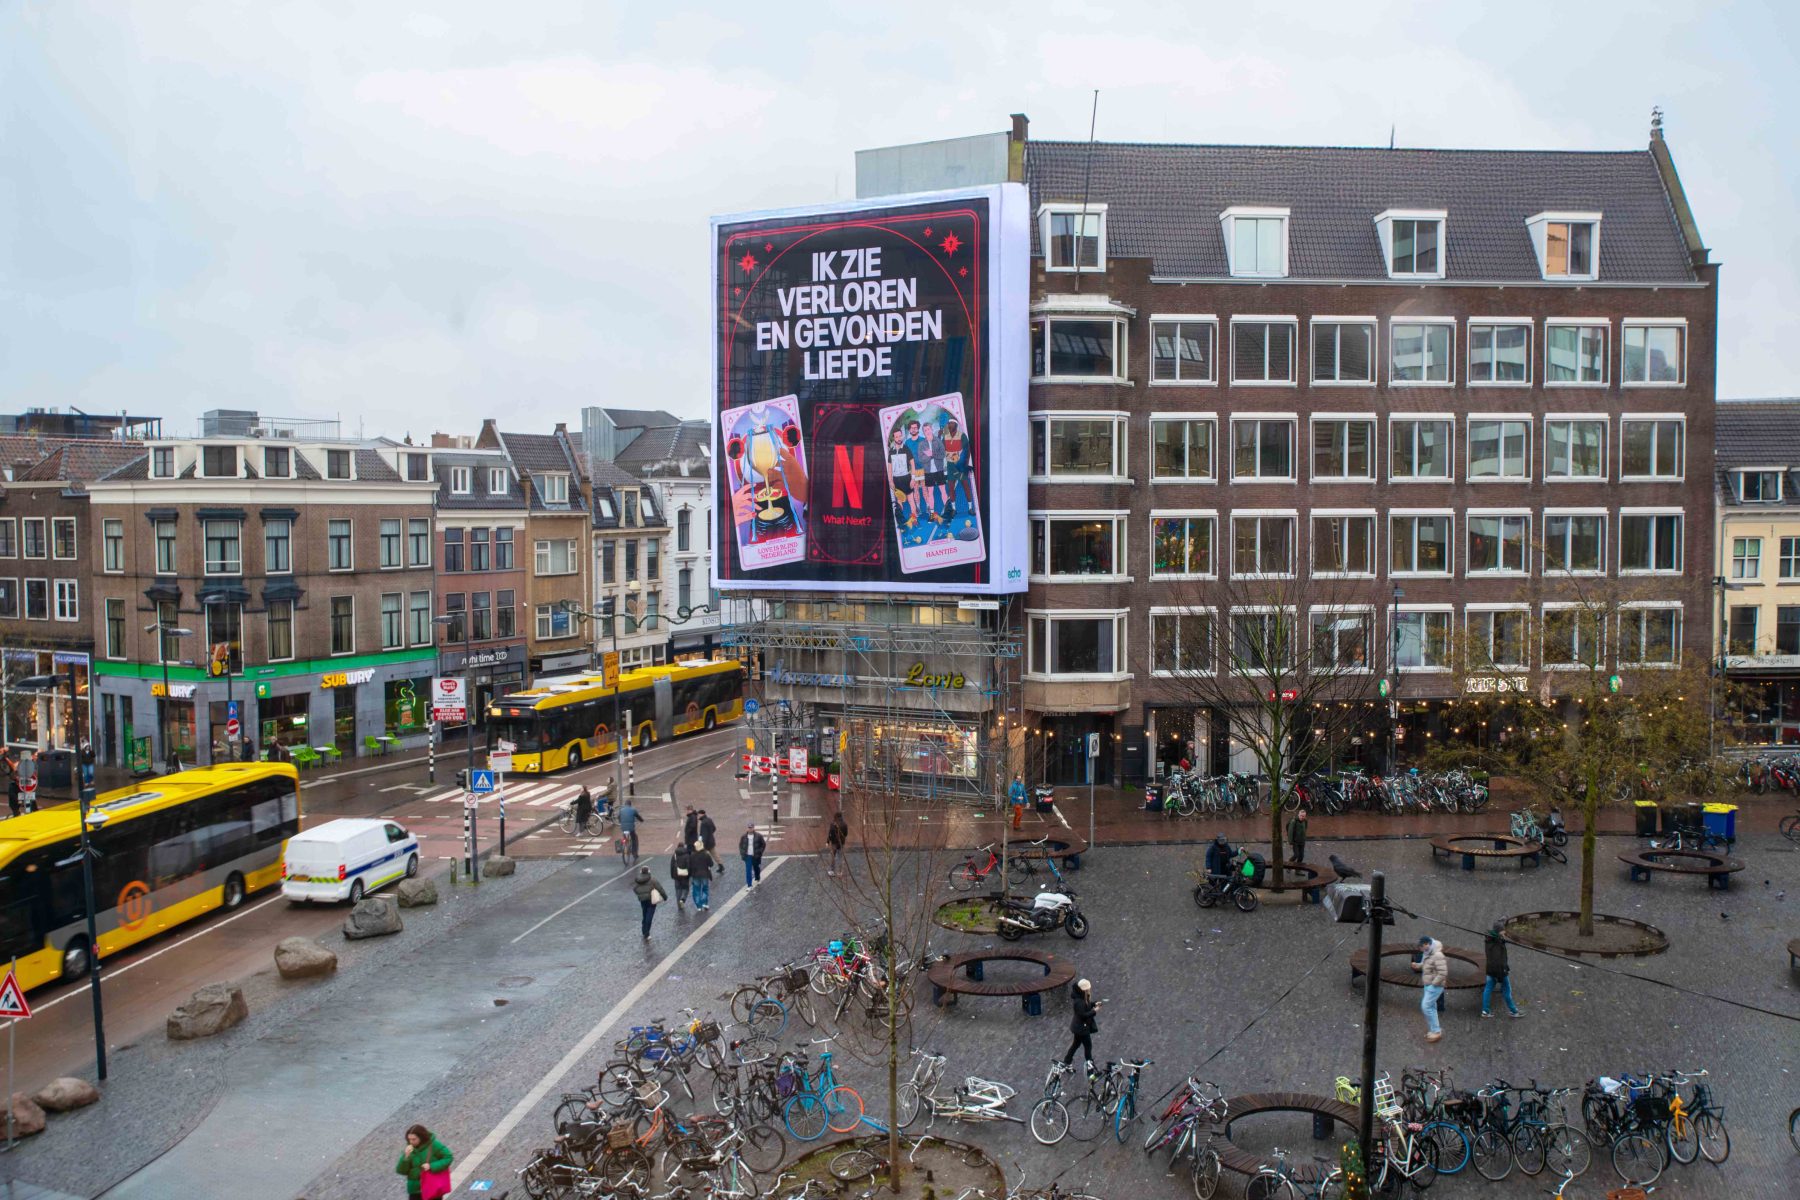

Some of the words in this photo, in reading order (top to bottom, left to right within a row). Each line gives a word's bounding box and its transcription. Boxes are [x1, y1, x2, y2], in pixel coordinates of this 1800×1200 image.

[811, 249, 839, 283] IK
[840, 246, 882, 279] ZIE
[777, 277, 917, 318] VERLOREN
[757, 322, 789, 351] EN
[794, 309, 942, 348] GEVONDEN
[803, 346, 892, 380] LIEFDE
[822, 514, 844, 525] What
[845, 515, 872, 526] Next?
[760, 548, 797, 559] NEDERLAND
[925, 546, 958, 558] HAANTJES
[1007, 565, 1021, 578] echo
[478, 653, 495, 662] time
[322, 667, 375, 689] SUBWAY
[151, 683, 195, 698] SUBWAY
